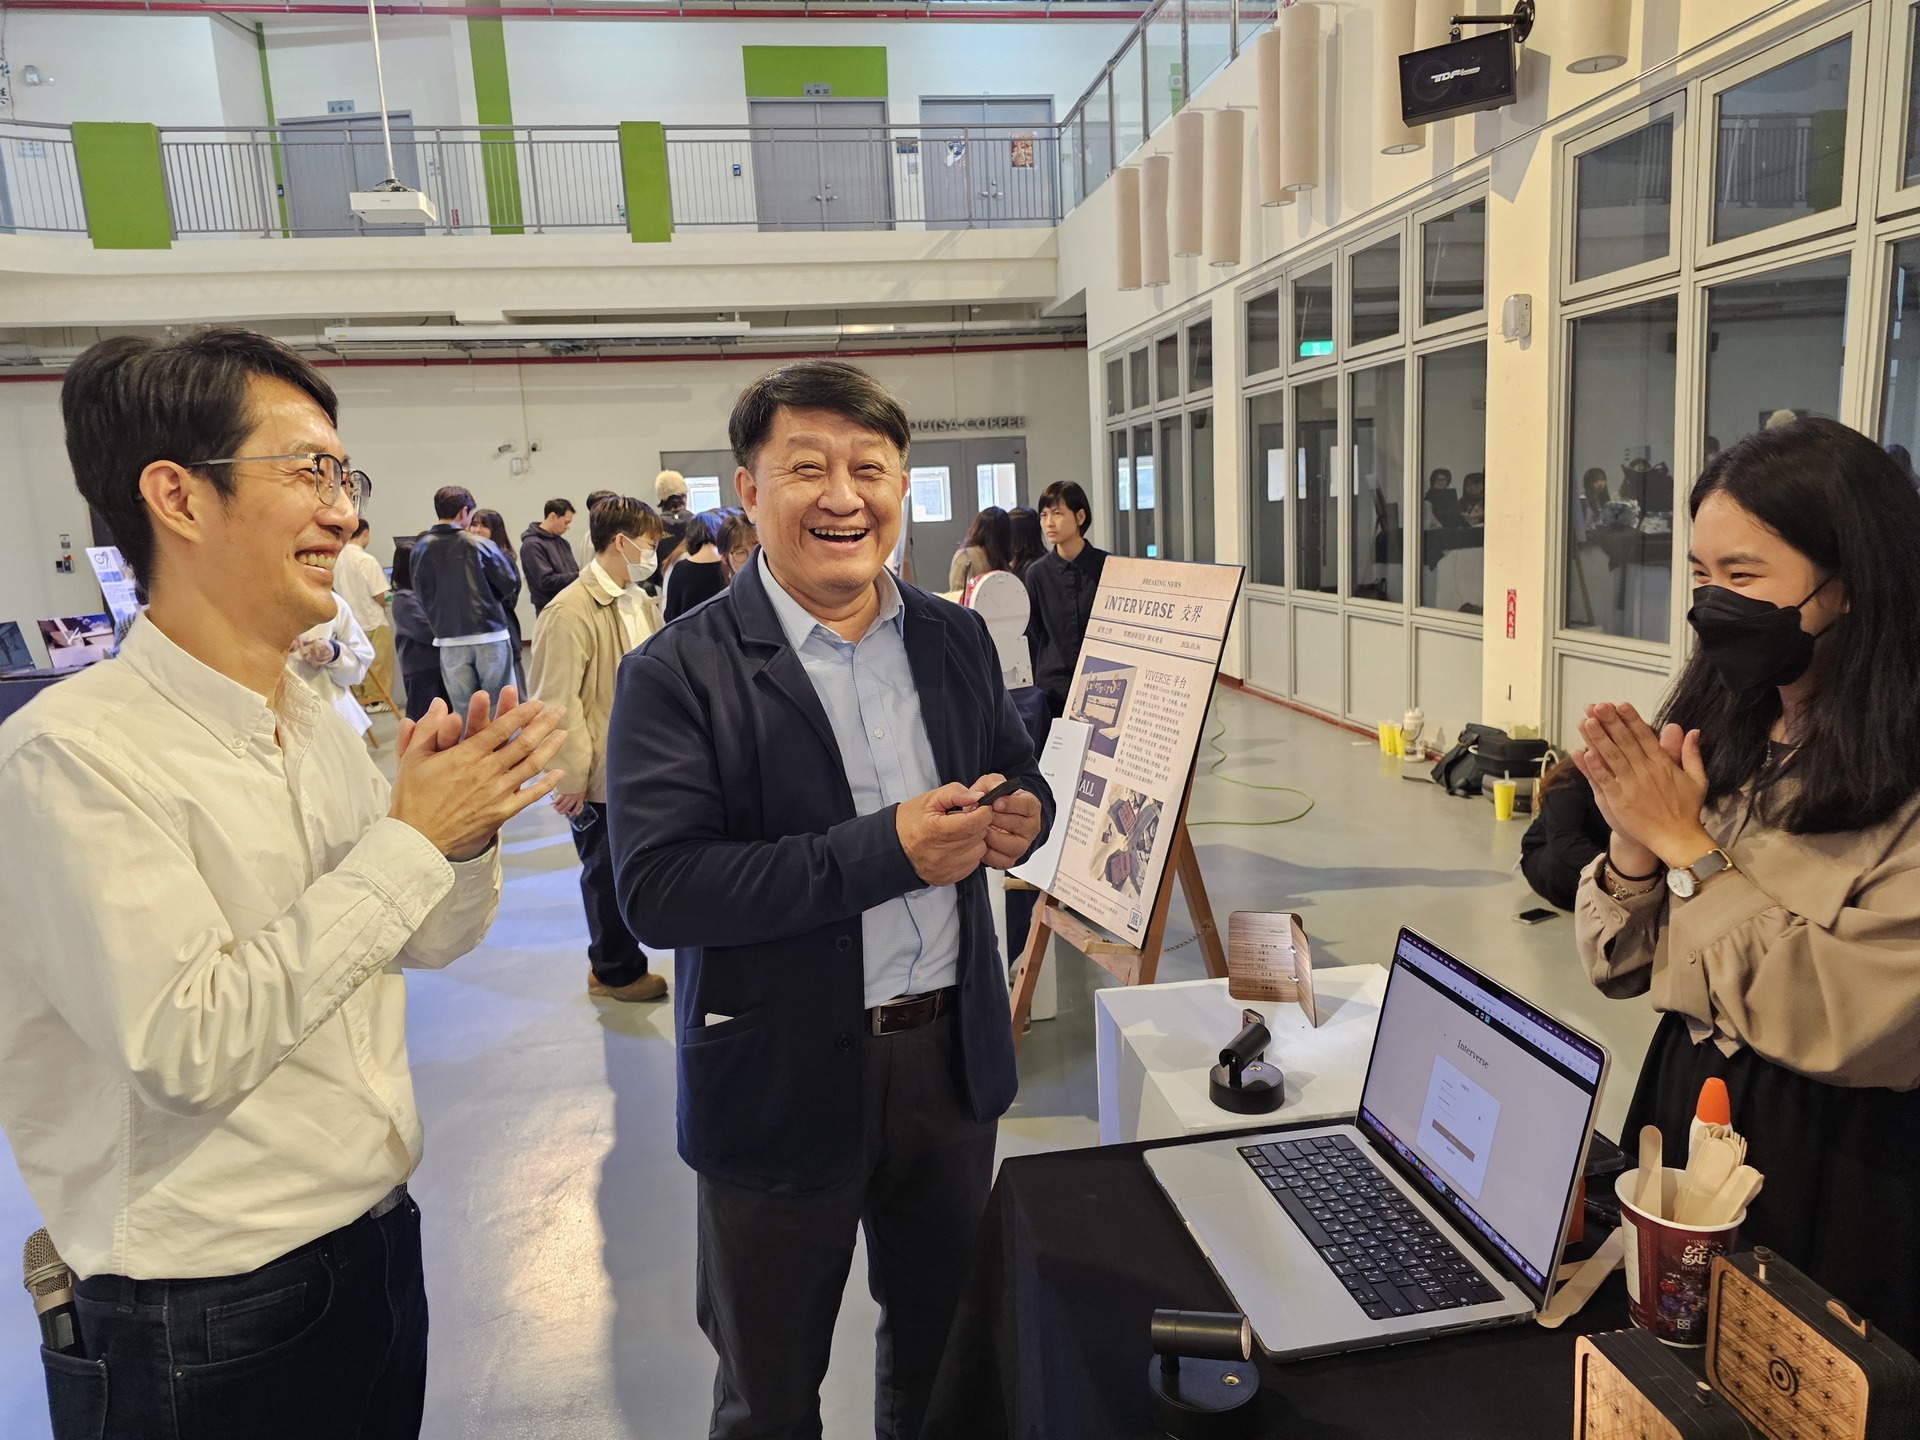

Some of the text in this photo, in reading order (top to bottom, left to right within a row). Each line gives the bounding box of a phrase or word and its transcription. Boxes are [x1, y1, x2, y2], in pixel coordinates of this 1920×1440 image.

[907, 416, 1027, 433] OUISA COFFEE
[1142, 578, 1181, 589] BREAKING NEWS
[1104, 595, 1203, 623] INTERVERSE 交界
[1145, 669, 1187, 689] VIVERSE 平台
[1078, 779, 1095, 797] ALL
[1457, 1039, 1489, 1069] Interverse
